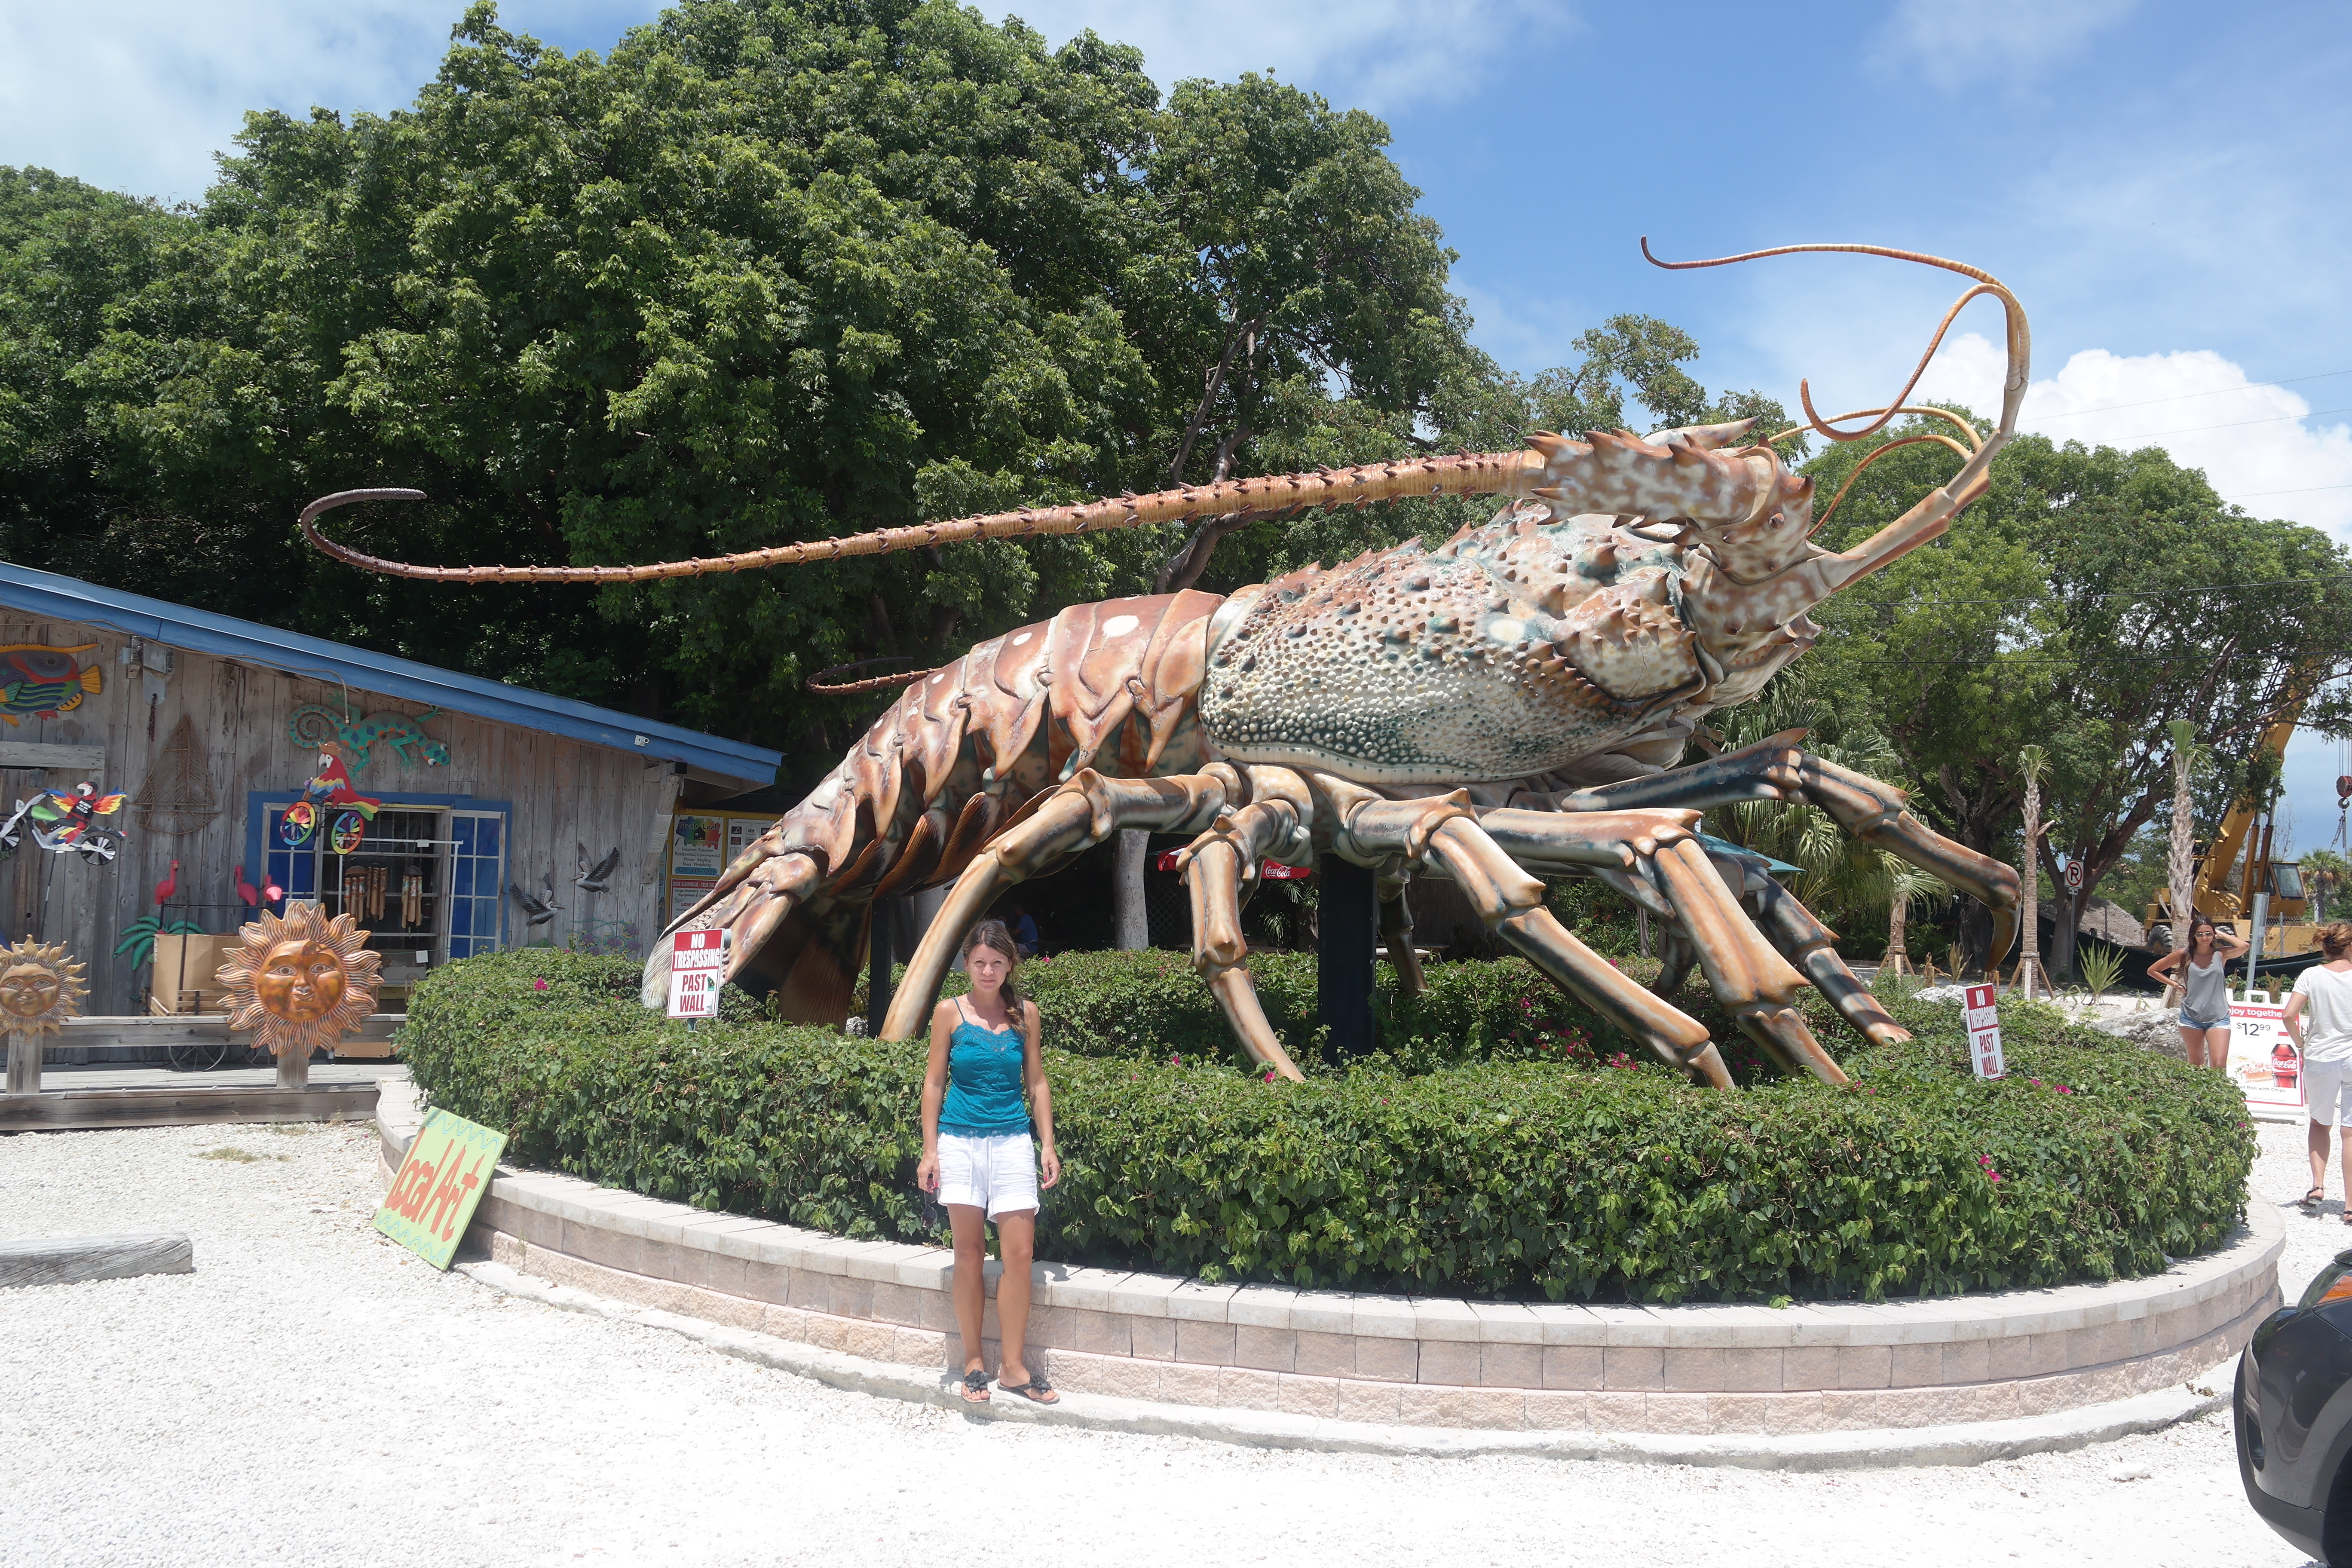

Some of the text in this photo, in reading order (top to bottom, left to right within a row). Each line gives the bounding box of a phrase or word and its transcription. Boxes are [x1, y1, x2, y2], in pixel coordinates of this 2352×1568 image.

[1265, 866, 1292, 877] Coca-Cola
[691, 933, 705, 949] NO
[674, 948, 720, 969] TRESPASSING
[682, 974, 707, 992] PAST
[680, 994, 704, 1012] WALL
[1975, 989, 1986, 1006] NO
[1969, 1004, 1998, 1029] TRESPASSING
[2228, 1007, 2282, 1017] njoy togethe
[1978, 1032, 1994, 1054] PAST
[1981, 1055, 1998, 1076] WALL
[384, 1127, 485, 1242] Local Art
